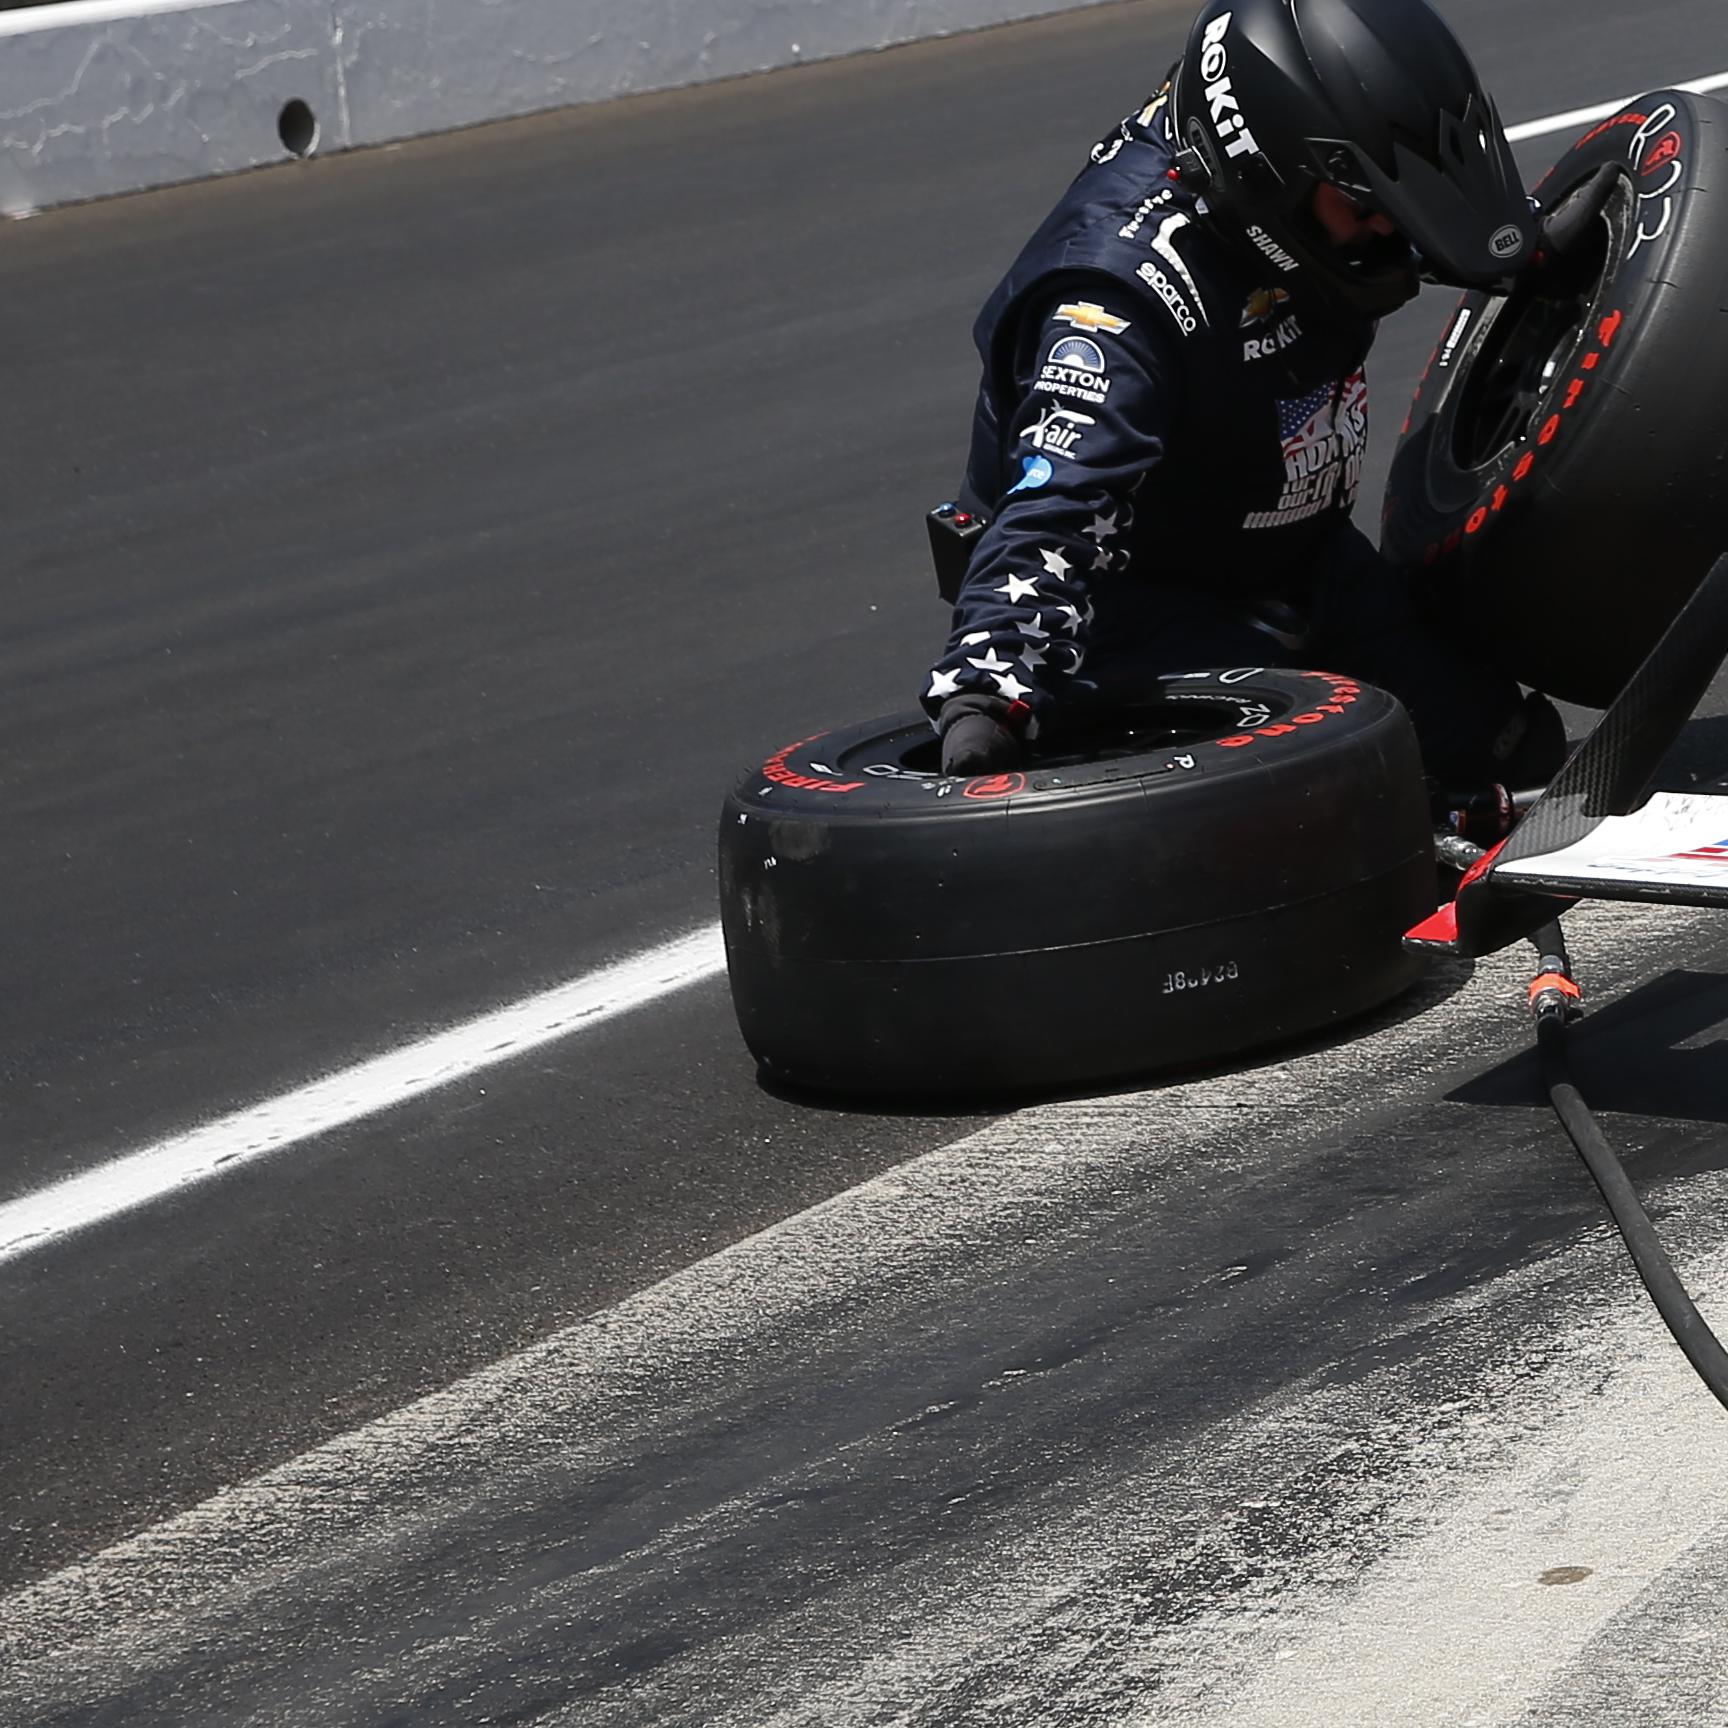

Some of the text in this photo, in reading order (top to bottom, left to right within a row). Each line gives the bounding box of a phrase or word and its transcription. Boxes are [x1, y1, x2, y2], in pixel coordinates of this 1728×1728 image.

[1246, 225, 1300, 272] SHAWN
[1494, 230, 1521, 253] BELL
[1136, 261, 1197, 333] sparco
[1040, 365, 1111, 393] SEXTON
